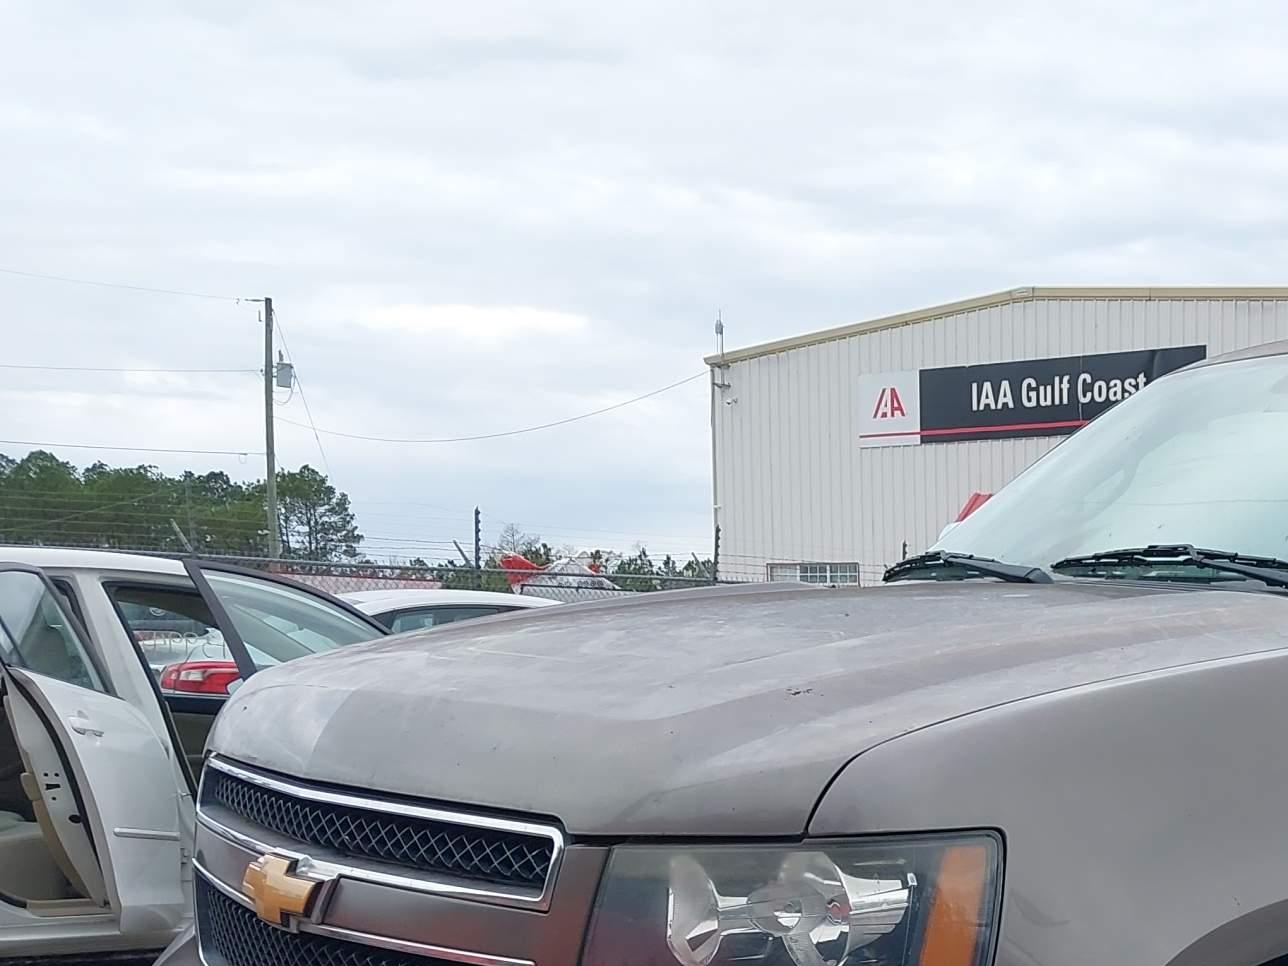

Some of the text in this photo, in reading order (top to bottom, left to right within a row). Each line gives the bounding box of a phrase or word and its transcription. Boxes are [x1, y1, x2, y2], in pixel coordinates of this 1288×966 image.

[971, 372, 1147, 411] IAA Gulf Coast
